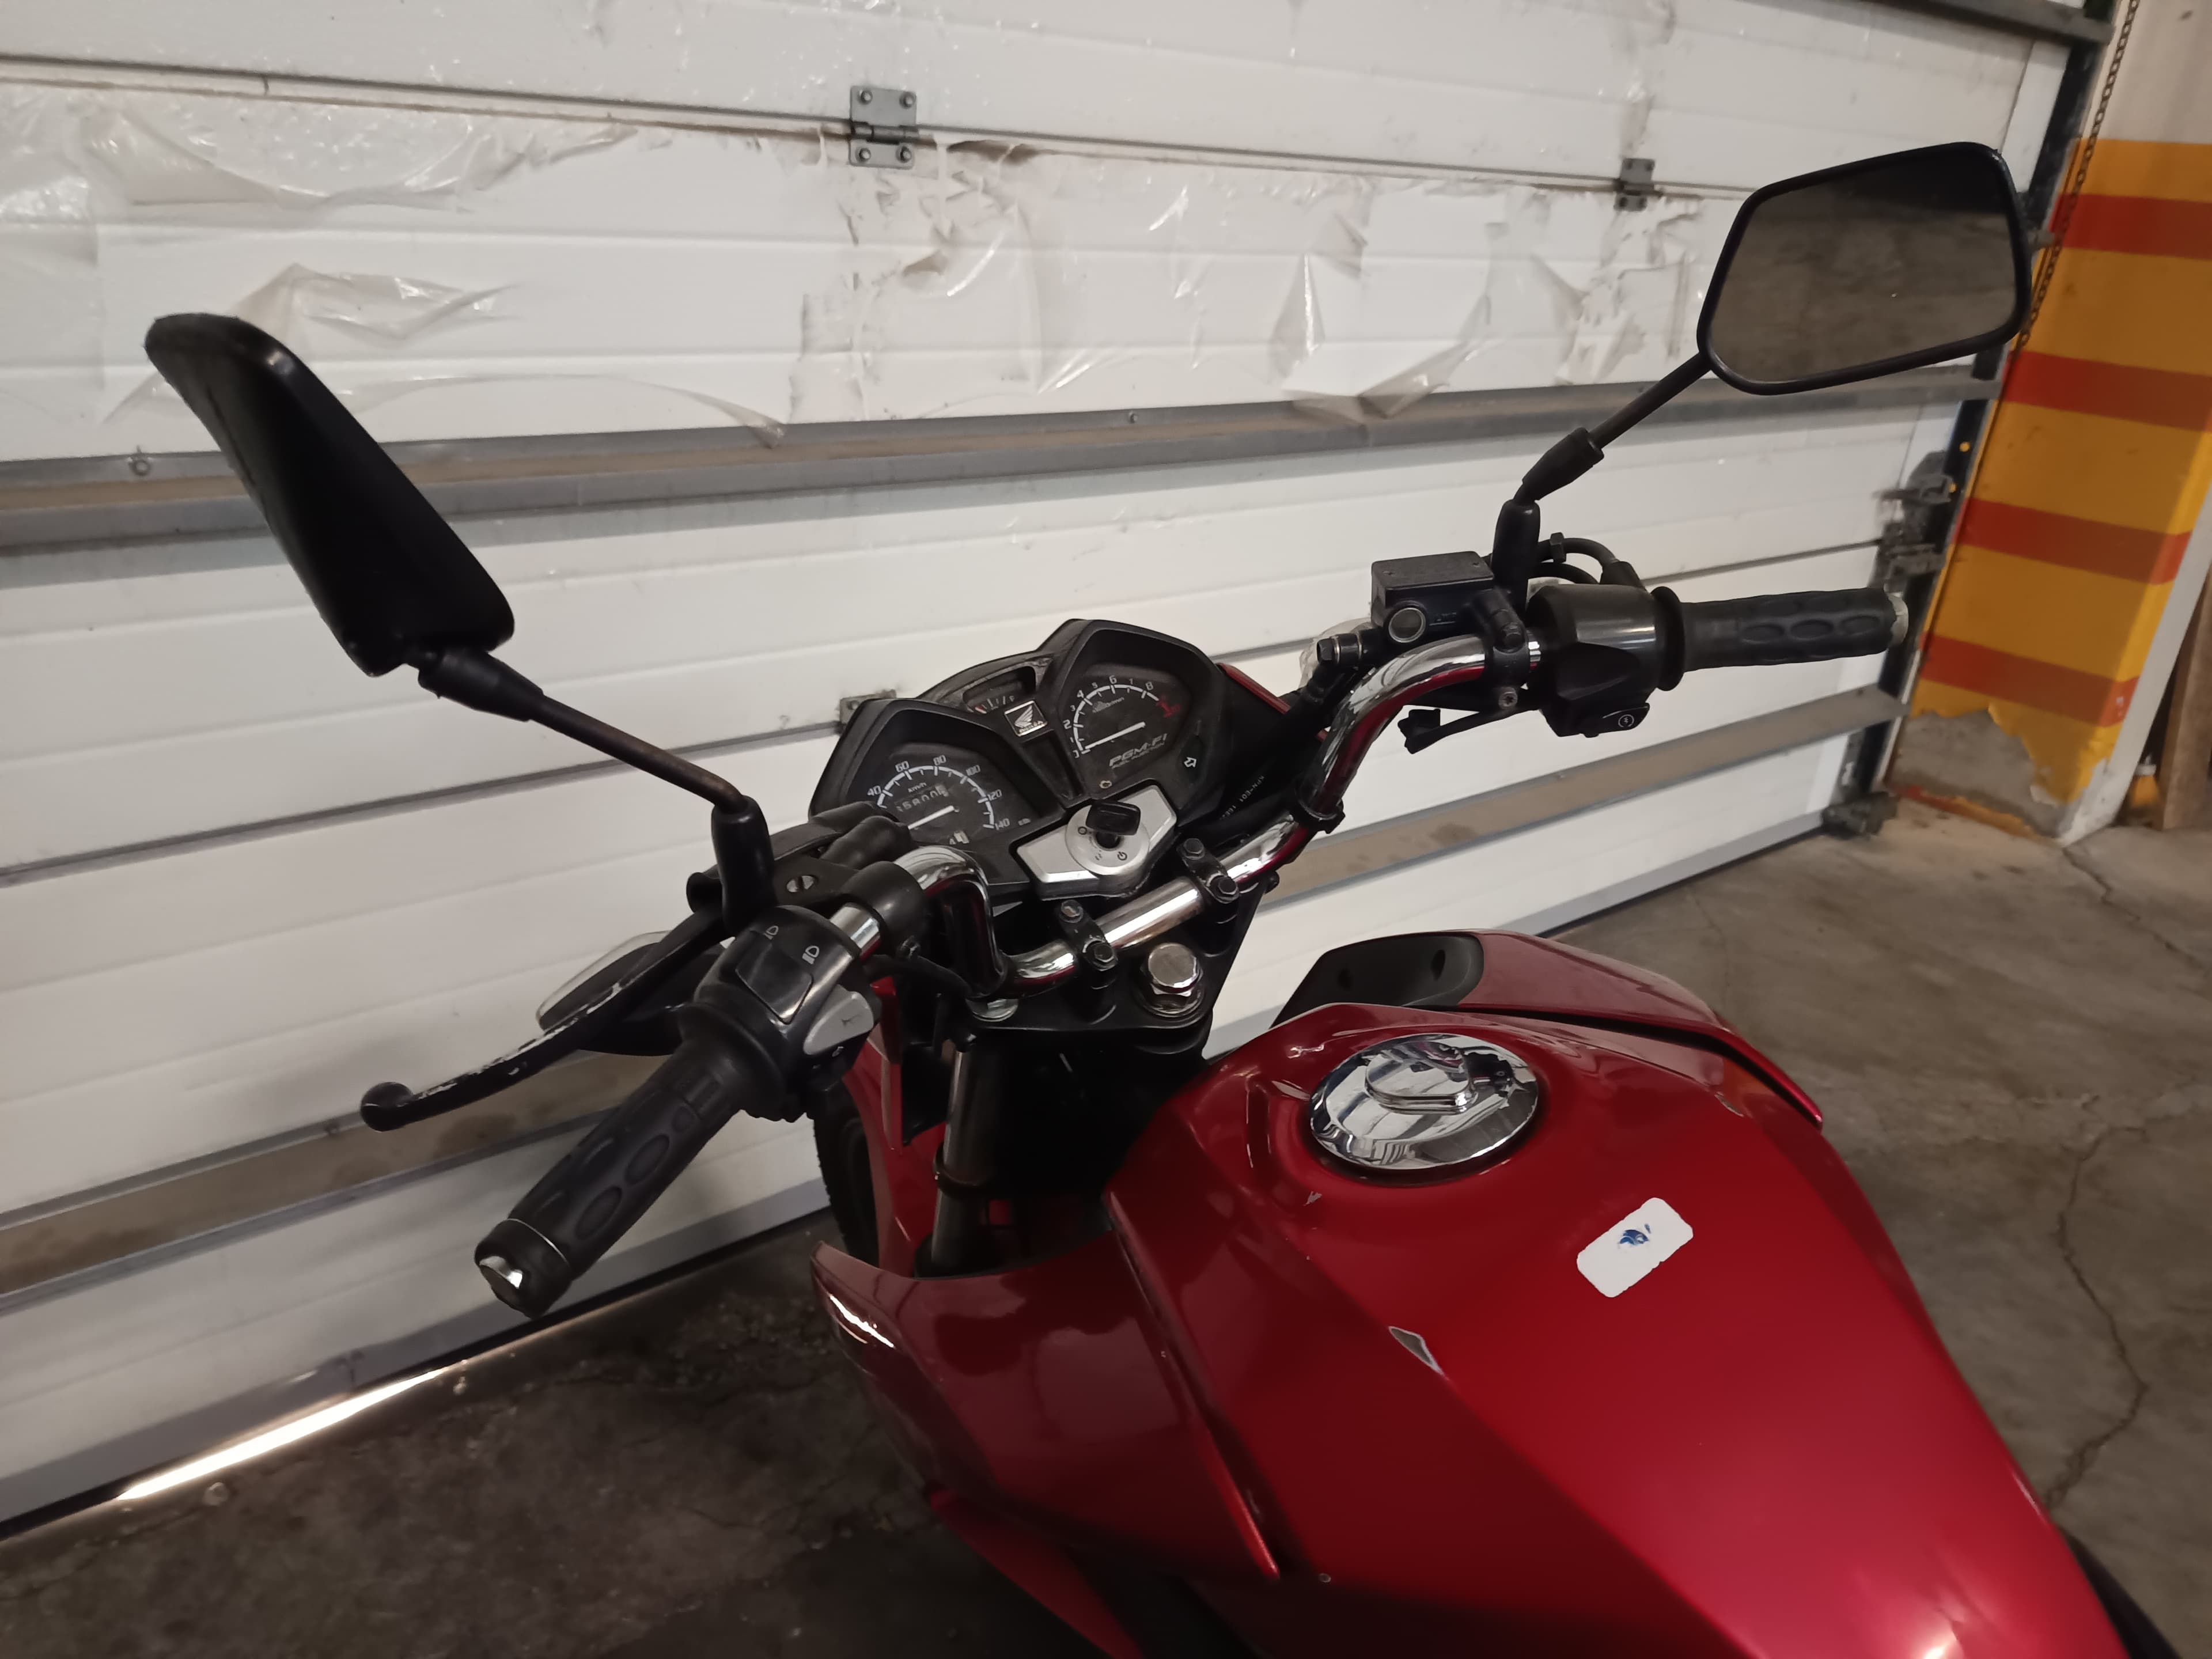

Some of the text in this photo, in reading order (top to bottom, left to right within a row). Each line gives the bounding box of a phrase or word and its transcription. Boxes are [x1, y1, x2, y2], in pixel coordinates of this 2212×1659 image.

[1109, 675, 1117, 684] 6
[1145, 681, 1153, 691] 8
[1077, 690, 1085, 698] 4
[1063, 719, 1071, 729] 2
[1109, 733, 1166, 767] PGM-FI
[895, 760, 910, 772] 60
[933, 755, 946, 766] 80
[965, 765, 981, 776] 100
[867, 786, 882, 796] 40
[987, 789, 1002, 801] 120
[995, 818, 1010, 830] 140
